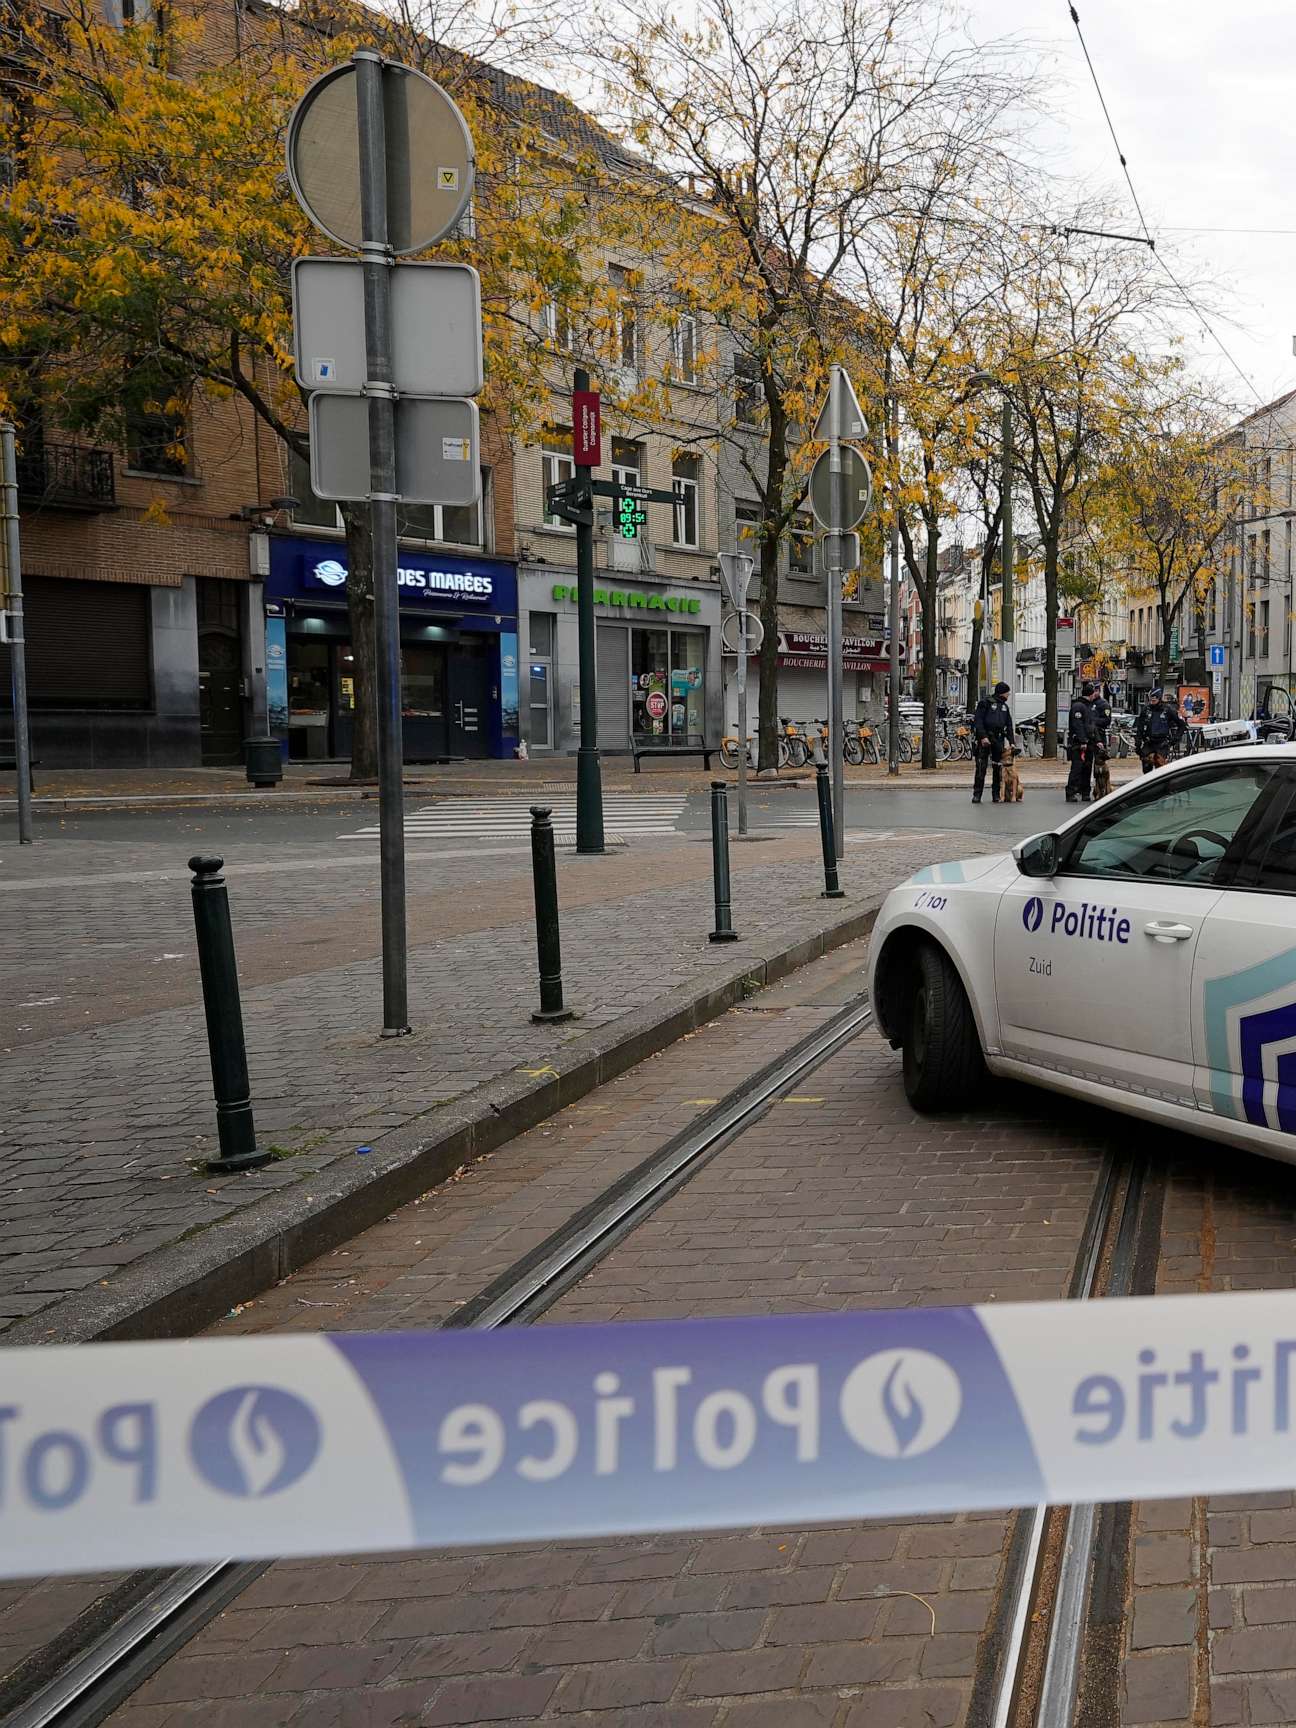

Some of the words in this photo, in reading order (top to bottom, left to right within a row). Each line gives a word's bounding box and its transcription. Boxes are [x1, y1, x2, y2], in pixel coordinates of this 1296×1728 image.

[397, 568, 426, 587] DES
[428, 572, 492, 593] MARÉES
[793, 634, 828, 645] BOUCHE
[783, 657, 827, 669] BOUCHERIE
[842, 661, 872, 671] AVILLON
[1051, 902, 1131, 944] Politie
[1029, 956, 1052, 977] Zuid
